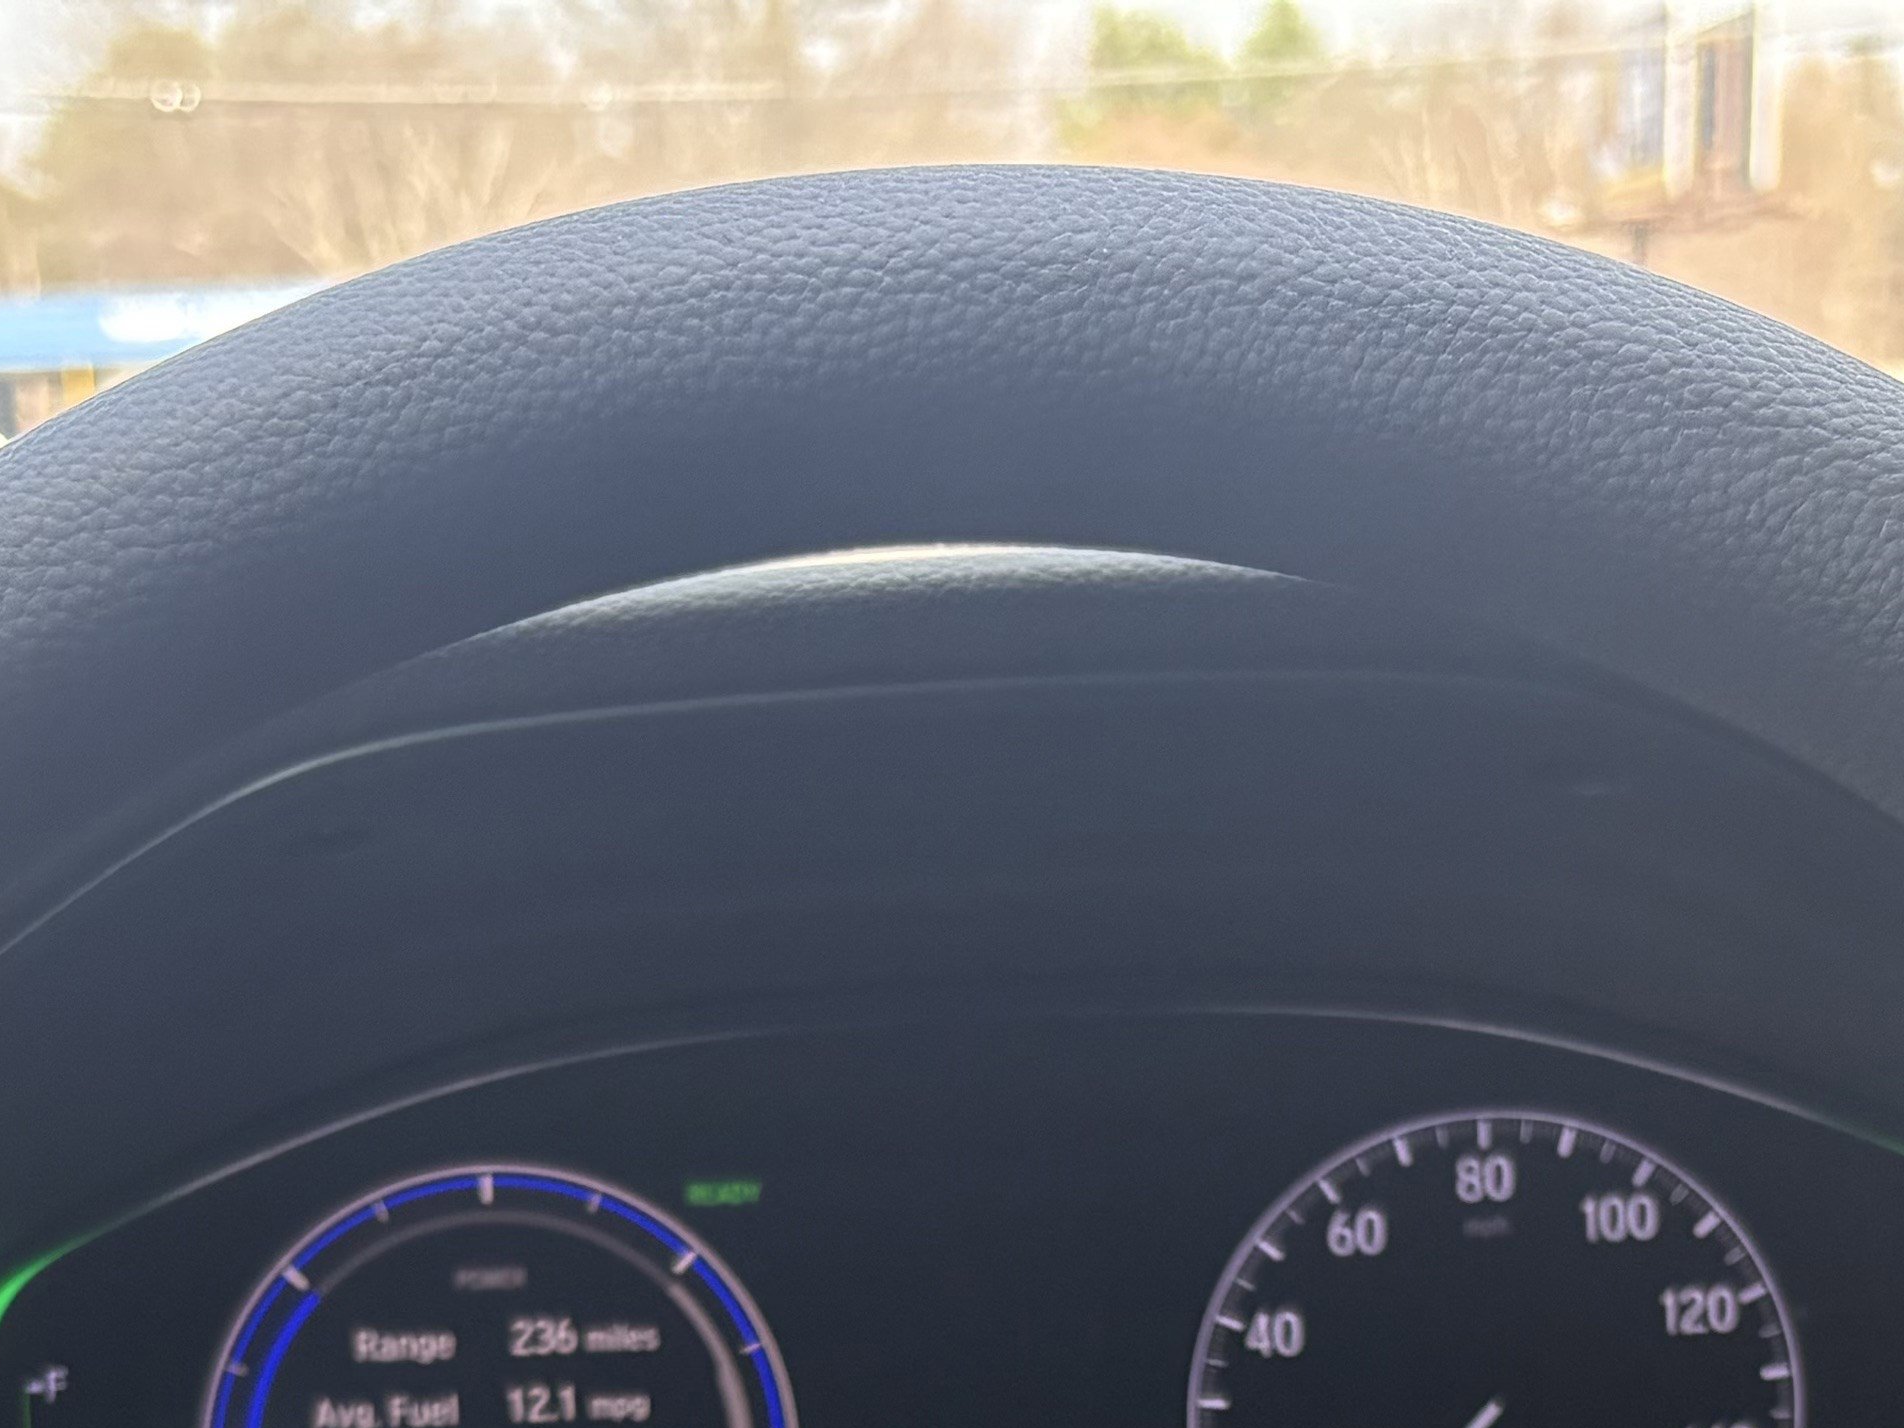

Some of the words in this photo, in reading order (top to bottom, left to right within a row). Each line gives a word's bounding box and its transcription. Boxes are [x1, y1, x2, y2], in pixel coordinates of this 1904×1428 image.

[1454, 1153, 1516, 1203] 80
[1326, 1206, 1389, 1257] 60
[1580, 1194, 1661, 1244] 100
[1244, 1309, 1306, 1359] 40
[1659, 1286, 1739, 1336] 120
[352, 1326, 459, 1365] Range
[508, 1317, 580, 1358] 236
[584, 1322, 662, 1354] miles
[387, 1393, 460, 1428] Fuel
[504, 1383, 577, 1425] 12.1
[587, 1392, 653, 1423] mpg
